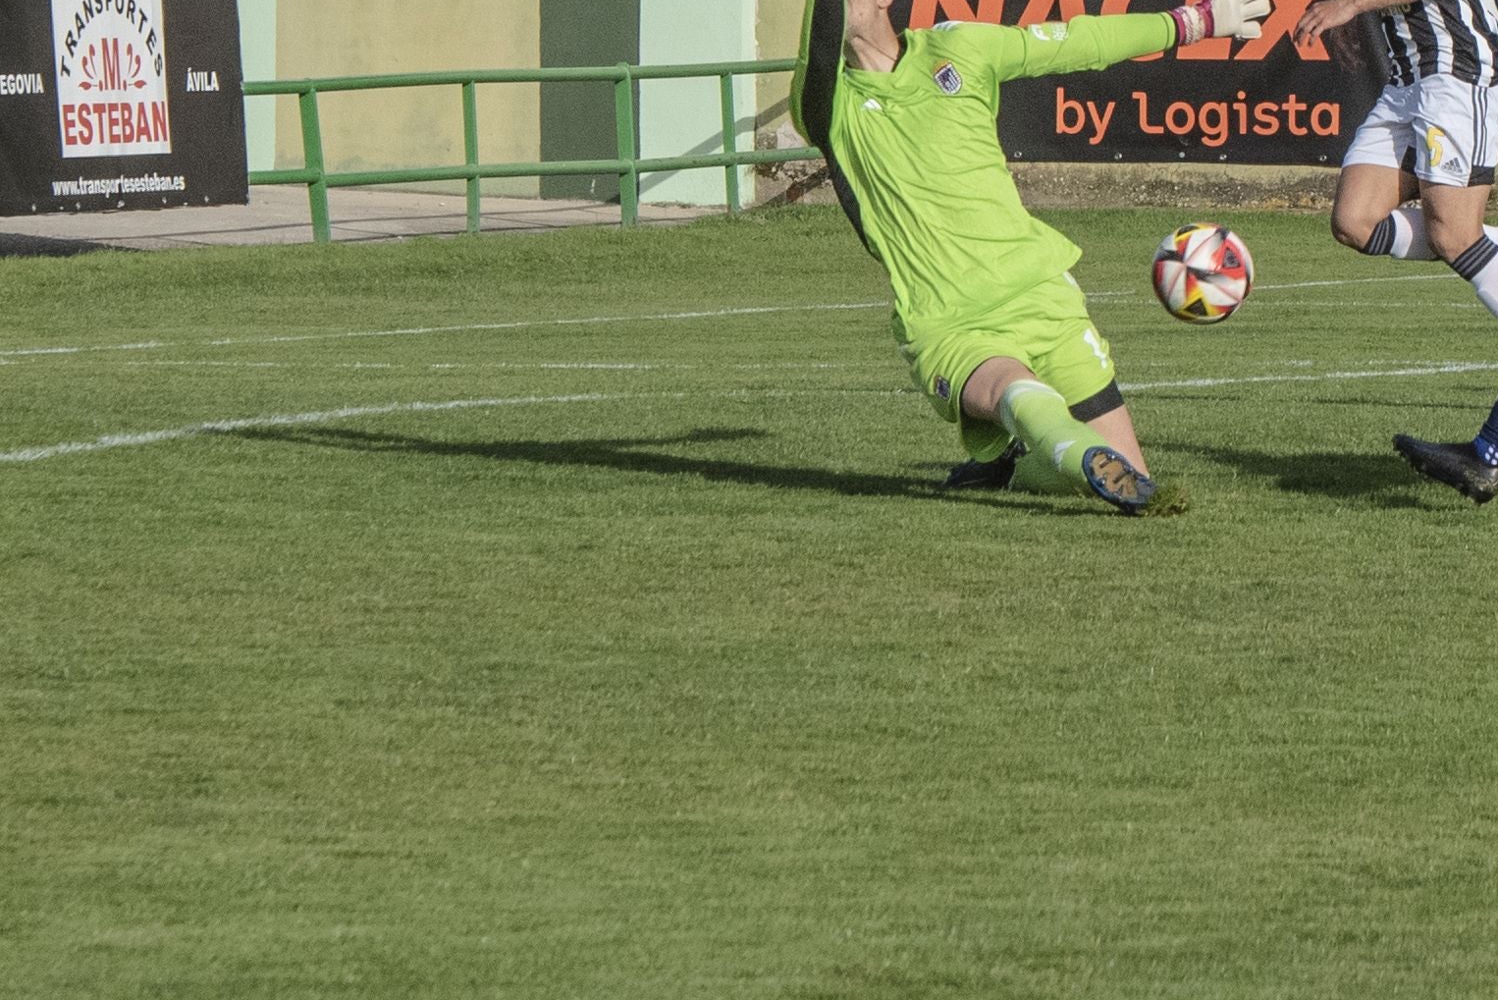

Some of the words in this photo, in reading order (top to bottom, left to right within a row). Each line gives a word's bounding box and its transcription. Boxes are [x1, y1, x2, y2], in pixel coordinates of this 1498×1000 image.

[186, 67, 220, 92] ÁVILA
[62, 101, 168, 146] ESTEBAN
[1055, 87, 1116, 145] by
[52, 173, 186, 198] www.transportesesteban.es
